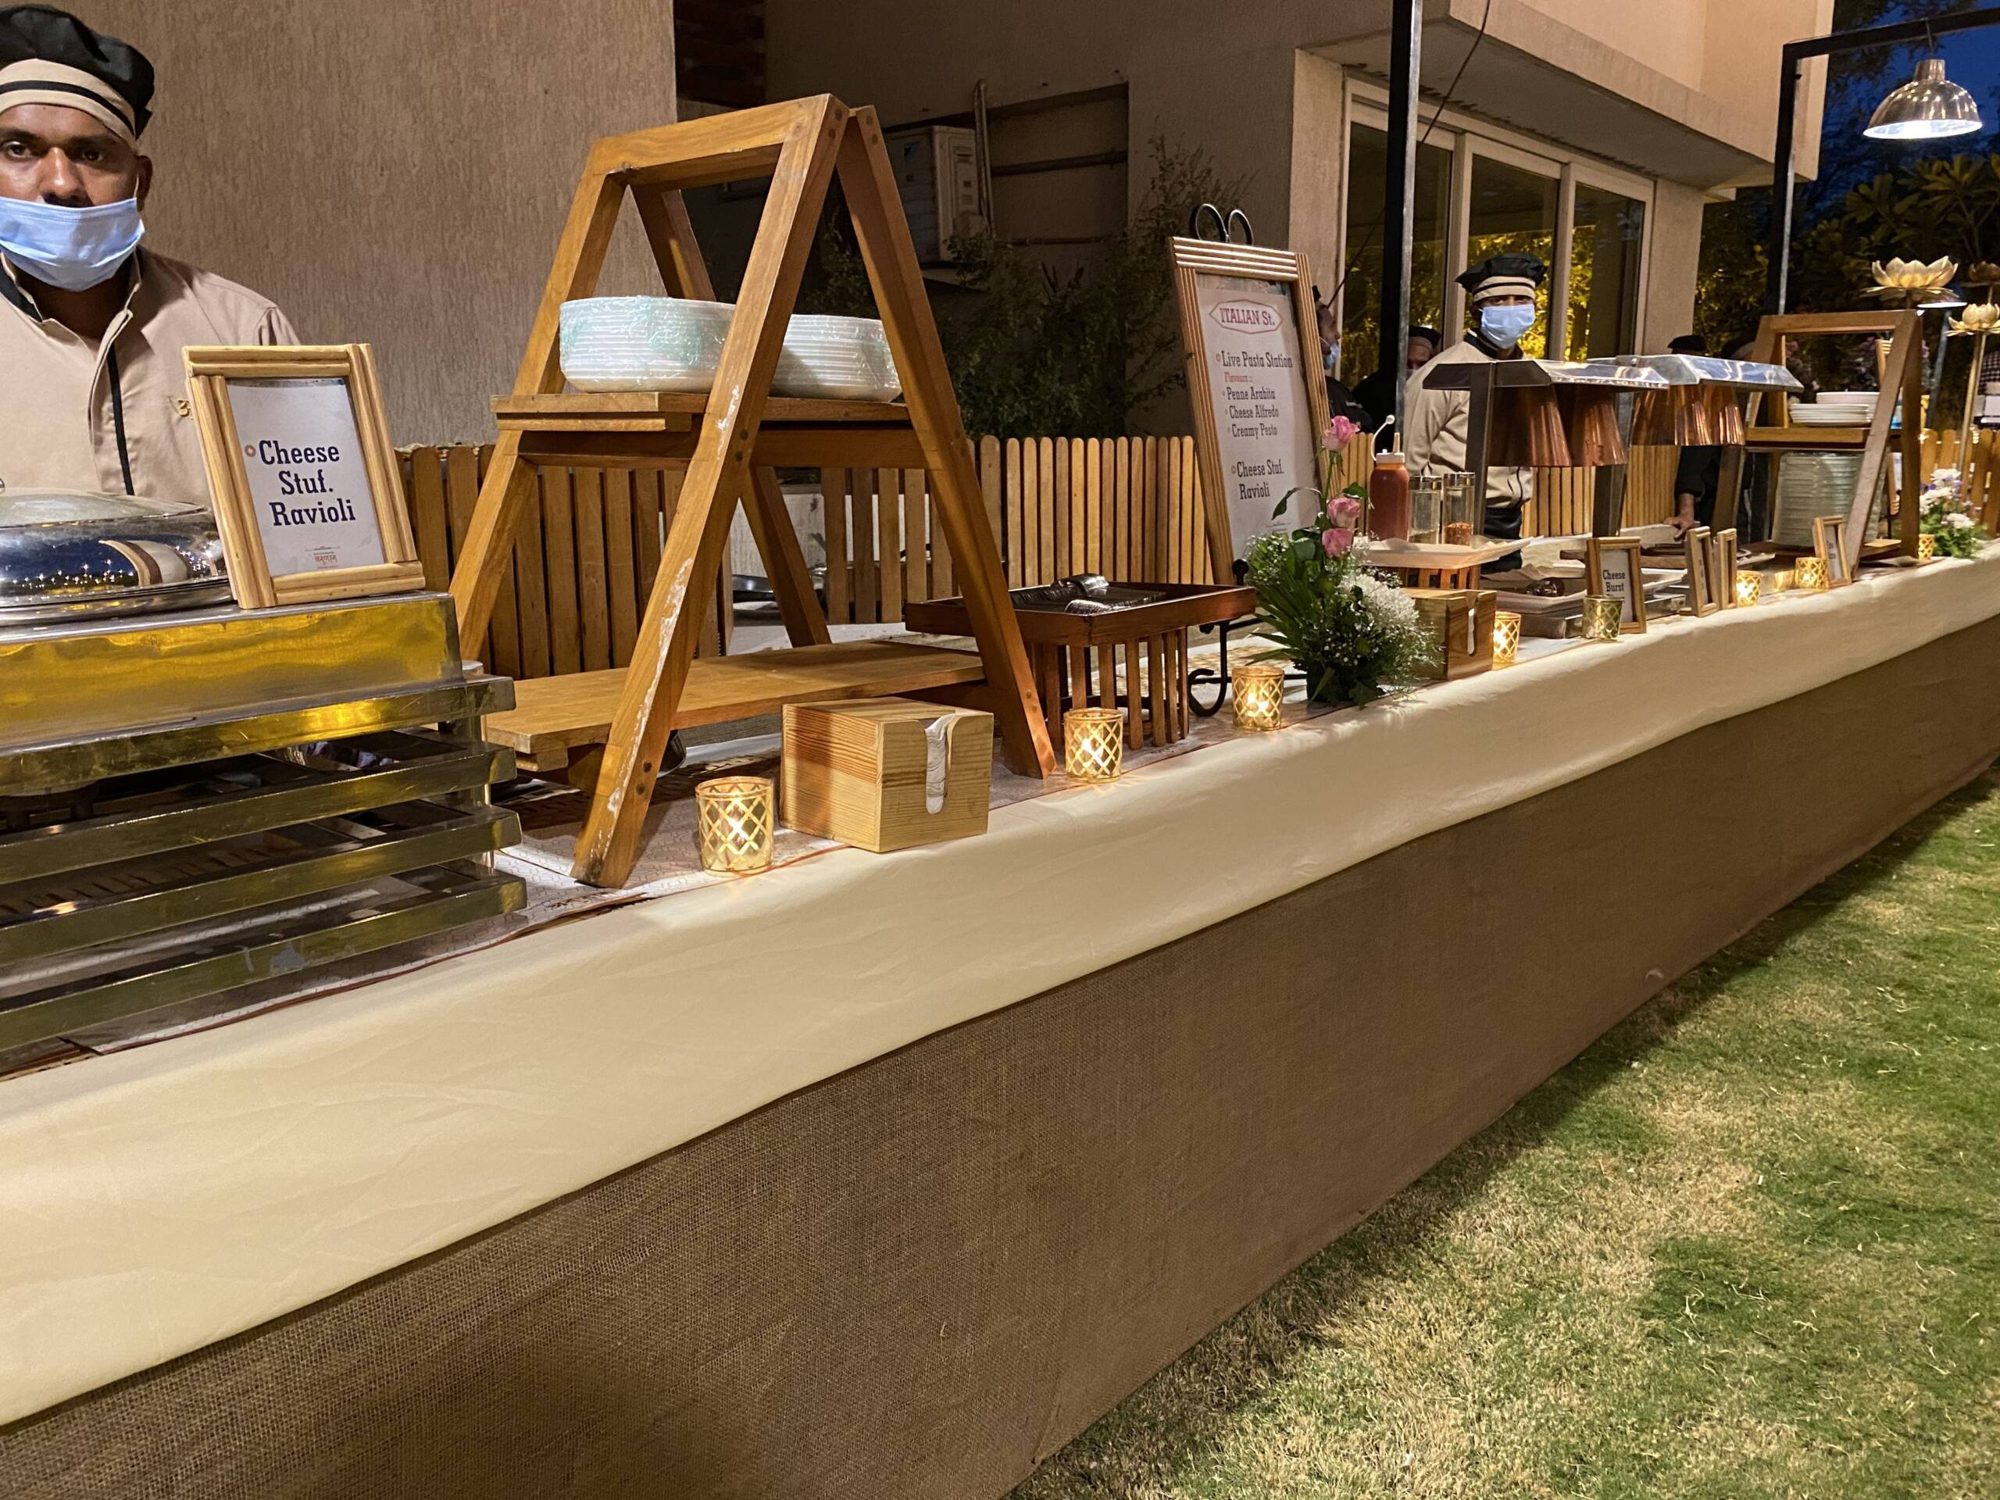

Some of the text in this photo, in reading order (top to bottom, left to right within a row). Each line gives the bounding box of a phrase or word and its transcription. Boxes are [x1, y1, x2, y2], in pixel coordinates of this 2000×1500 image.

[1219, 307, 1276, 326] ITALIAN St.
[1221, 350, 1294, 368] Live Pasta Station
[1226, 386, 1249, 400] Penne
[1229, 404, 1279, 419] Cheese Alfredo
[1231, 422, 1278, 440] Creamy Pesto
[258, 439, 340, 466] Cheese
[1236, 460, 1266, 478] Cheese
[278, 468, 334, 496] Stuf.
[1238, 481, 1270, 500] Ravioli
[269, 497, 356, 527] Ravioli
[1602, 569, 1626, 580] Cheese
[1605, 581, 1625, 592] Burst
